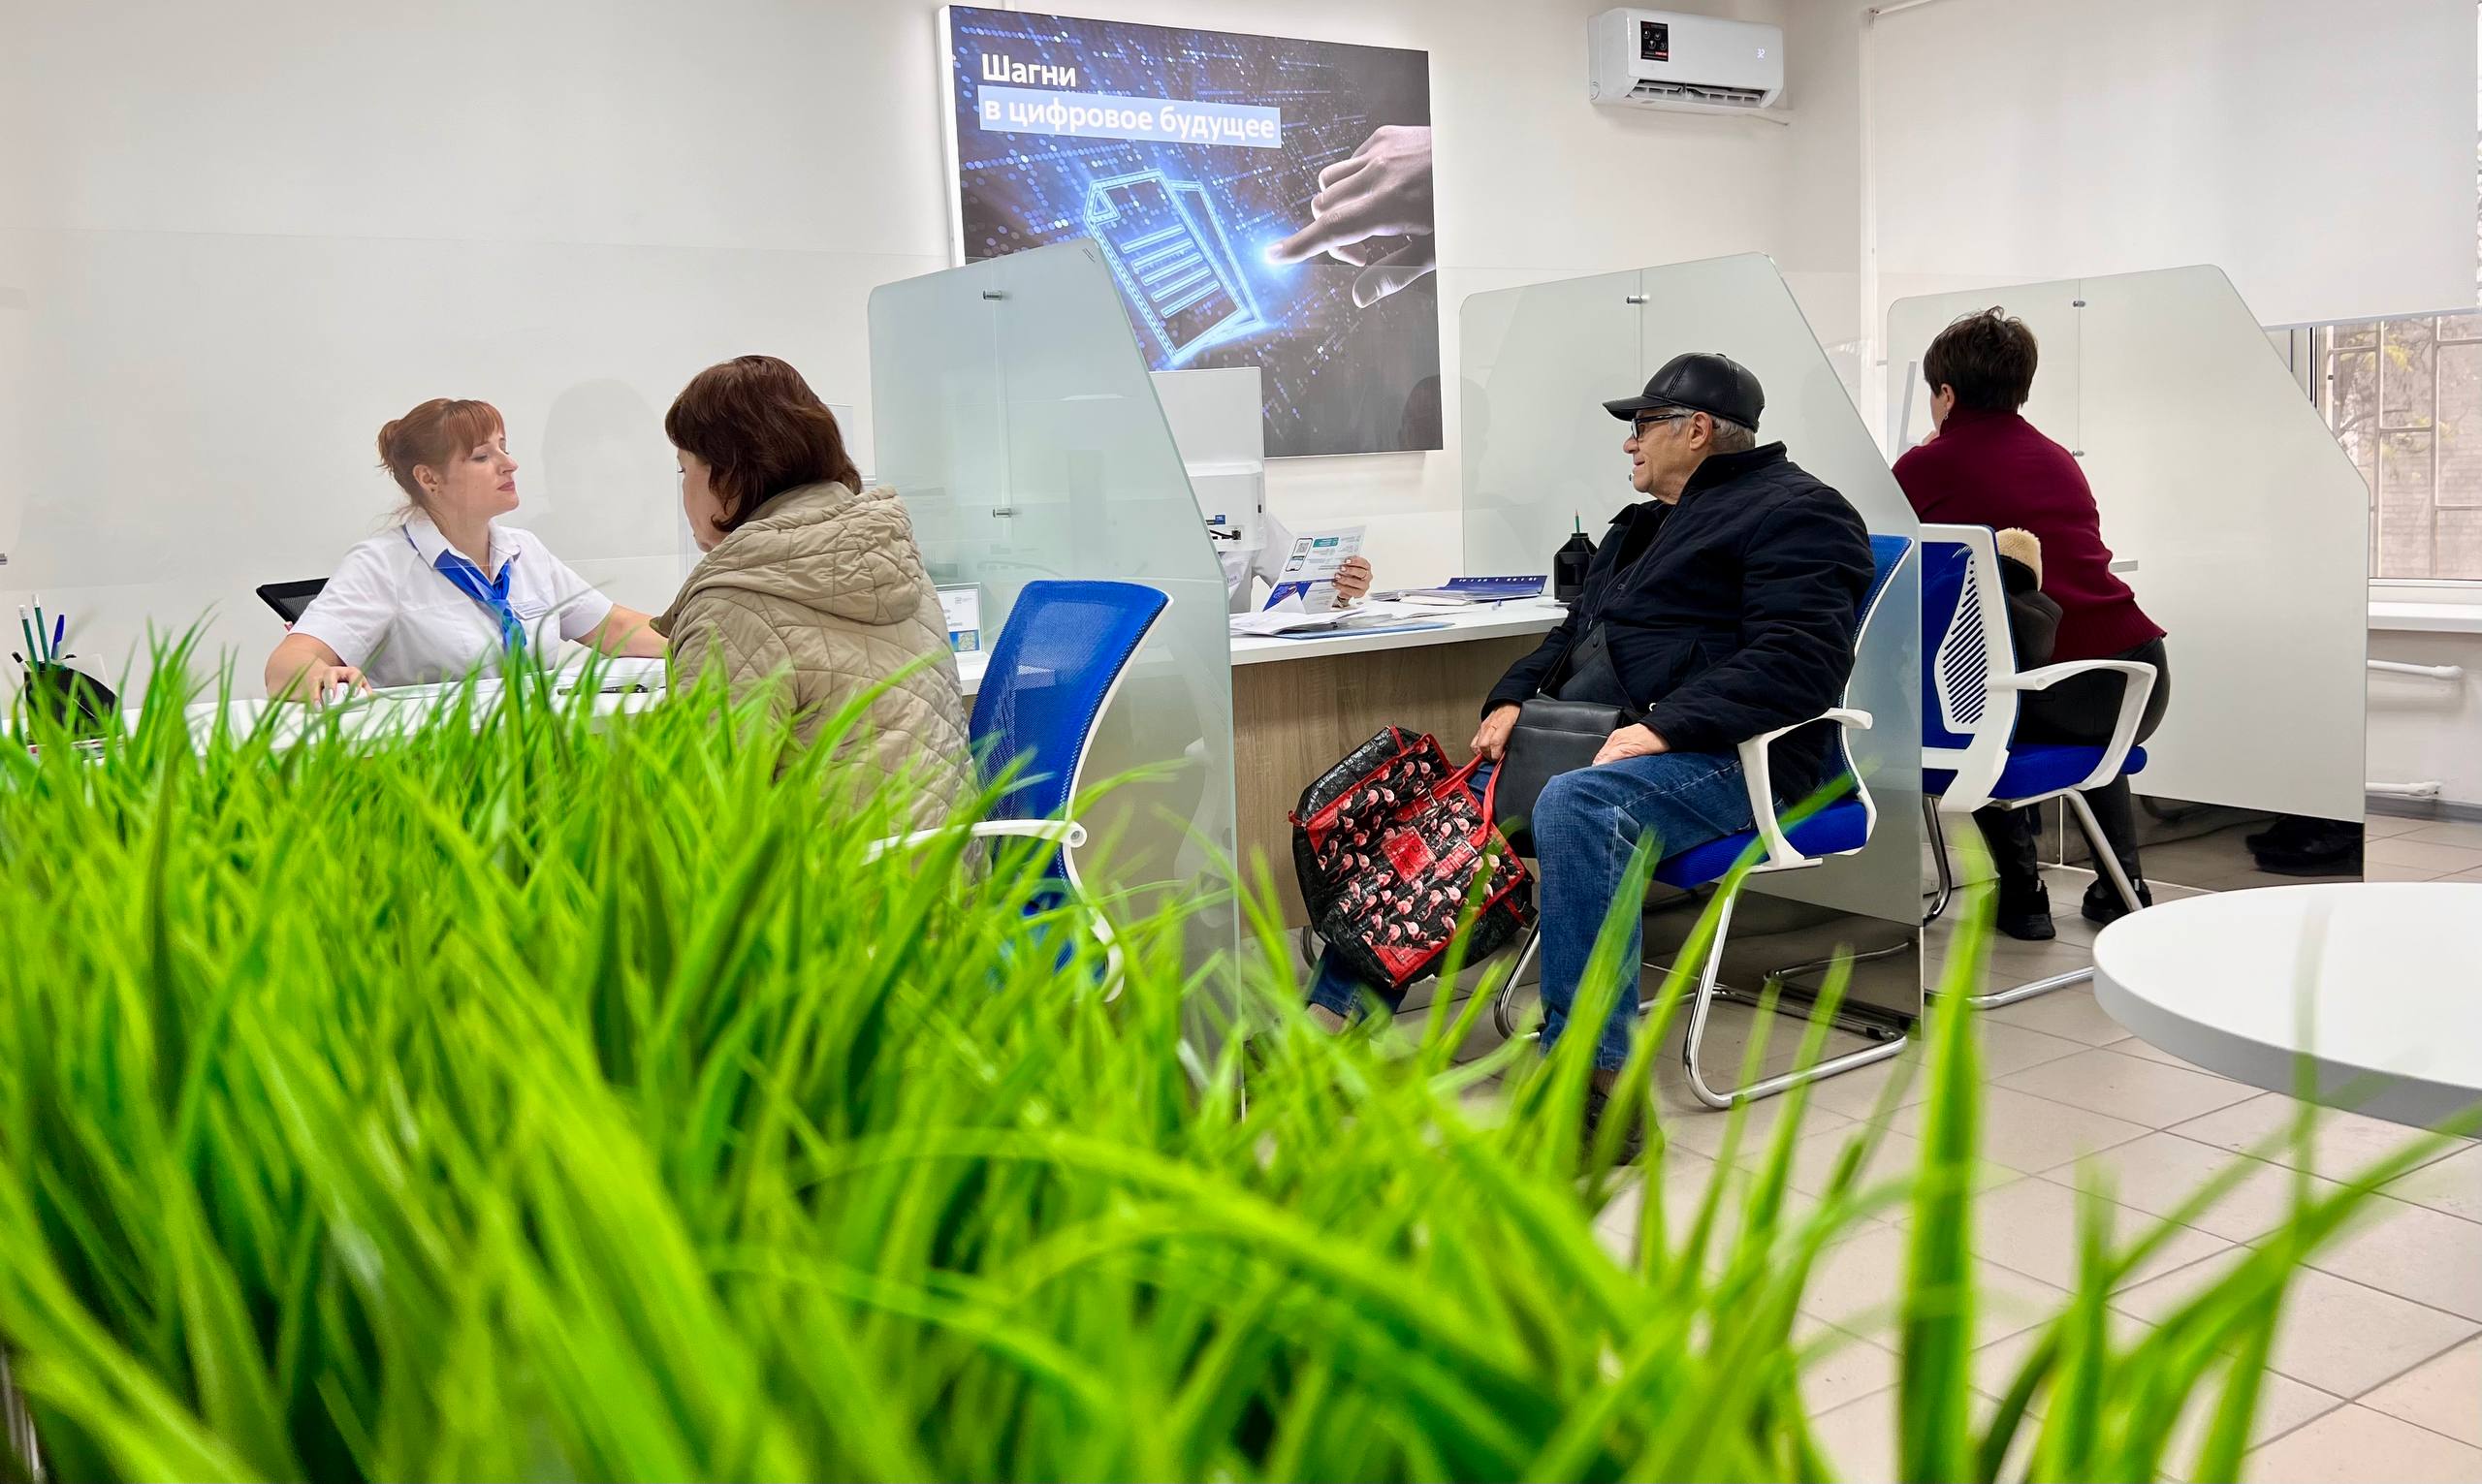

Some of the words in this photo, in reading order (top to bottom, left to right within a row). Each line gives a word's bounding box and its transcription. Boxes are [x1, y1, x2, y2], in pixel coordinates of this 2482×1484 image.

[981, 53, 1077, 87] Шагни
[984, 100, 1002, 121] в
[1008, 97, 1154, 134] цифровое
[1160, 105, 1276, 142] будущее
